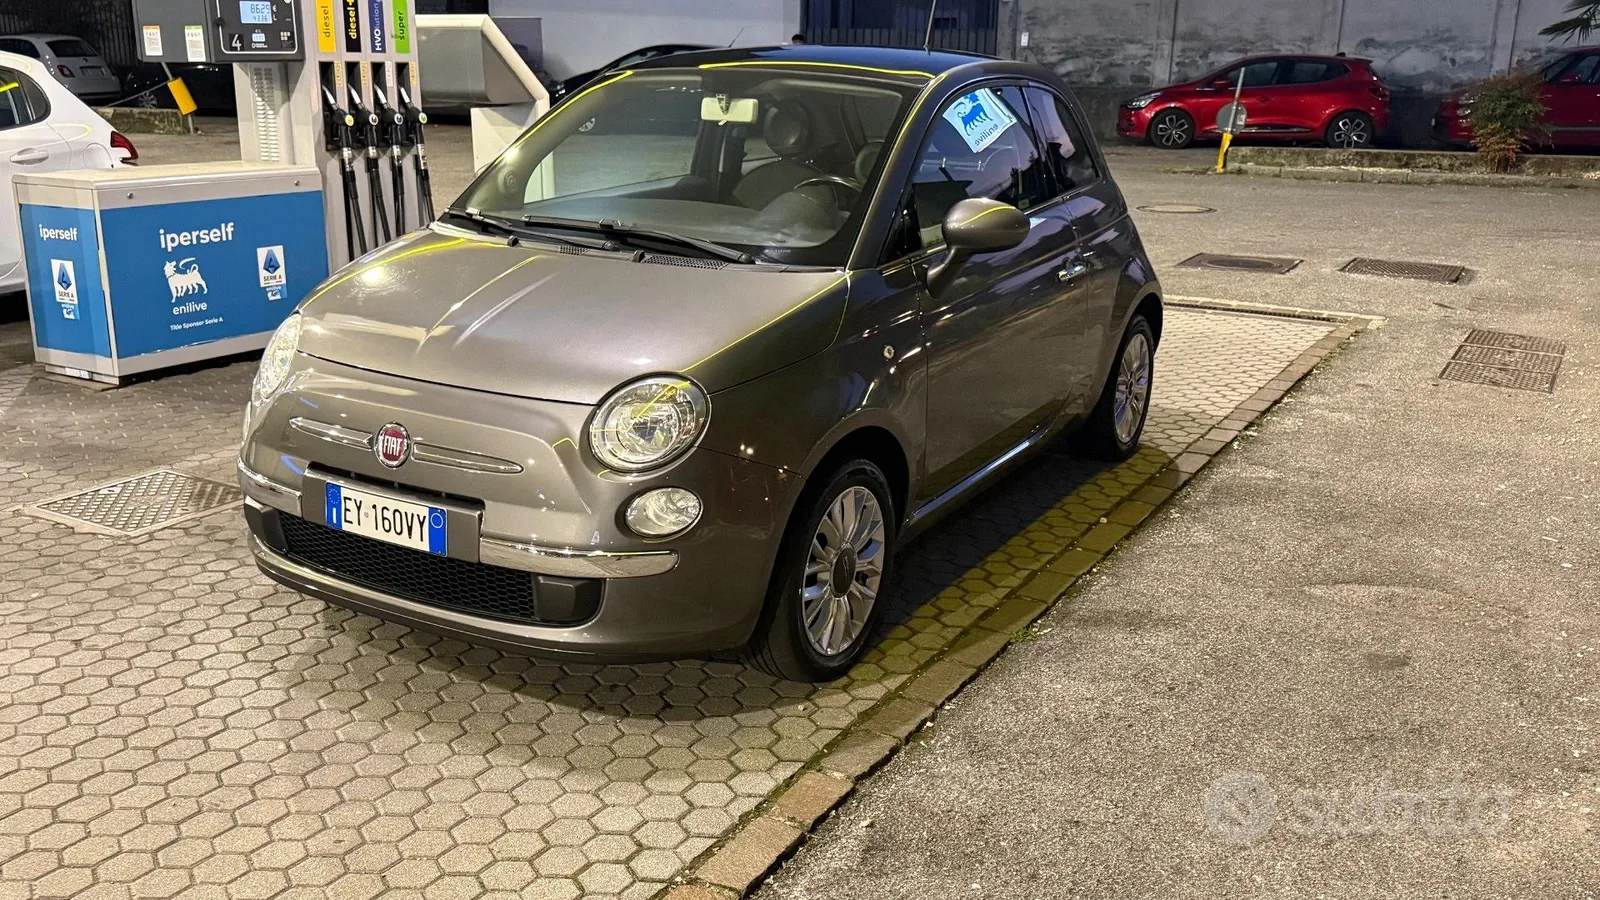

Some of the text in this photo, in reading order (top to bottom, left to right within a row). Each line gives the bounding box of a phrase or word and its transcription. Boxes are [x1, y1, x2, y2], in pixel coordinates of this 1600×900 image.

[321, 5, 331, 38] diesel
[397, 11, 406, 40] super
[231, 33, 242, 51] 4
[38, 223, 78, 241] iperself
[158, 221, 235, 252] iperself
[172, 301, 208, 315] enilive
[182, 320, 204, 329] Sponsor
[205, 317, 218, 325] Serie
[383, 435, 402, 456] FIAT
[343, 497, 426, 542] EY 160VY
